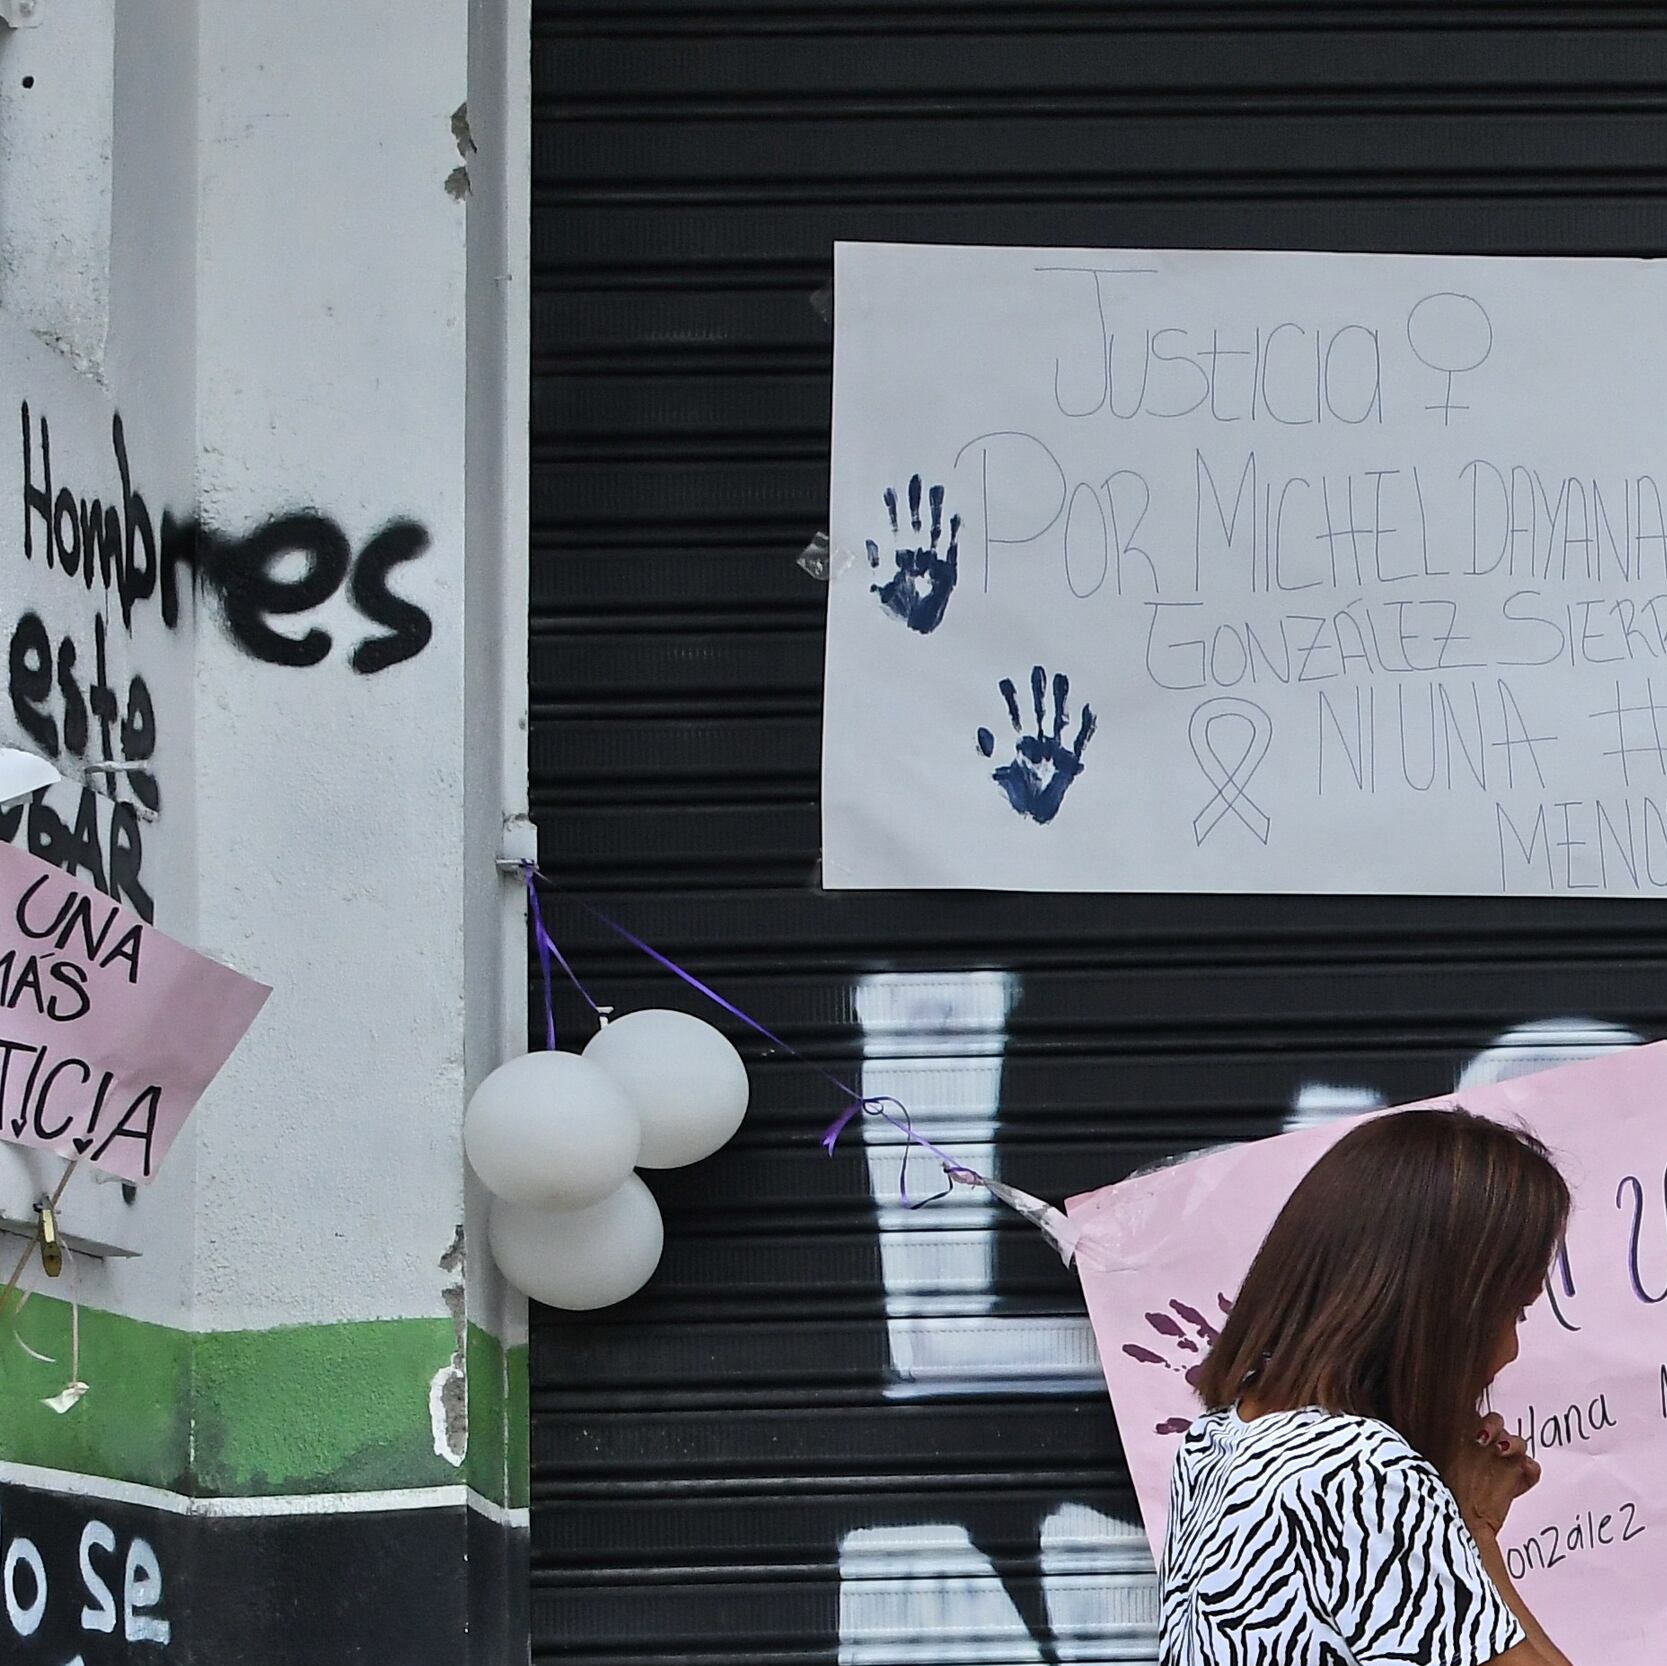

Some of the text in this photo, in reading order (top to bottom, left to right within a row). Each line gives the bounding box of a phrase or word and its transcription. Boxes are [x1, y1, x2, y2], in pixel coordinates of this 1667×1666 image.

[20, 400, 435, 676] Hombres
[1196, 449, 1450, 593] MICHEL
[16, 873, 144, 986] UNA
[0, 1038, 163, 1178] TICIA
[2, 1519, 171, 1646] o se
[1506, 1501, 1647, 1580] onzález
